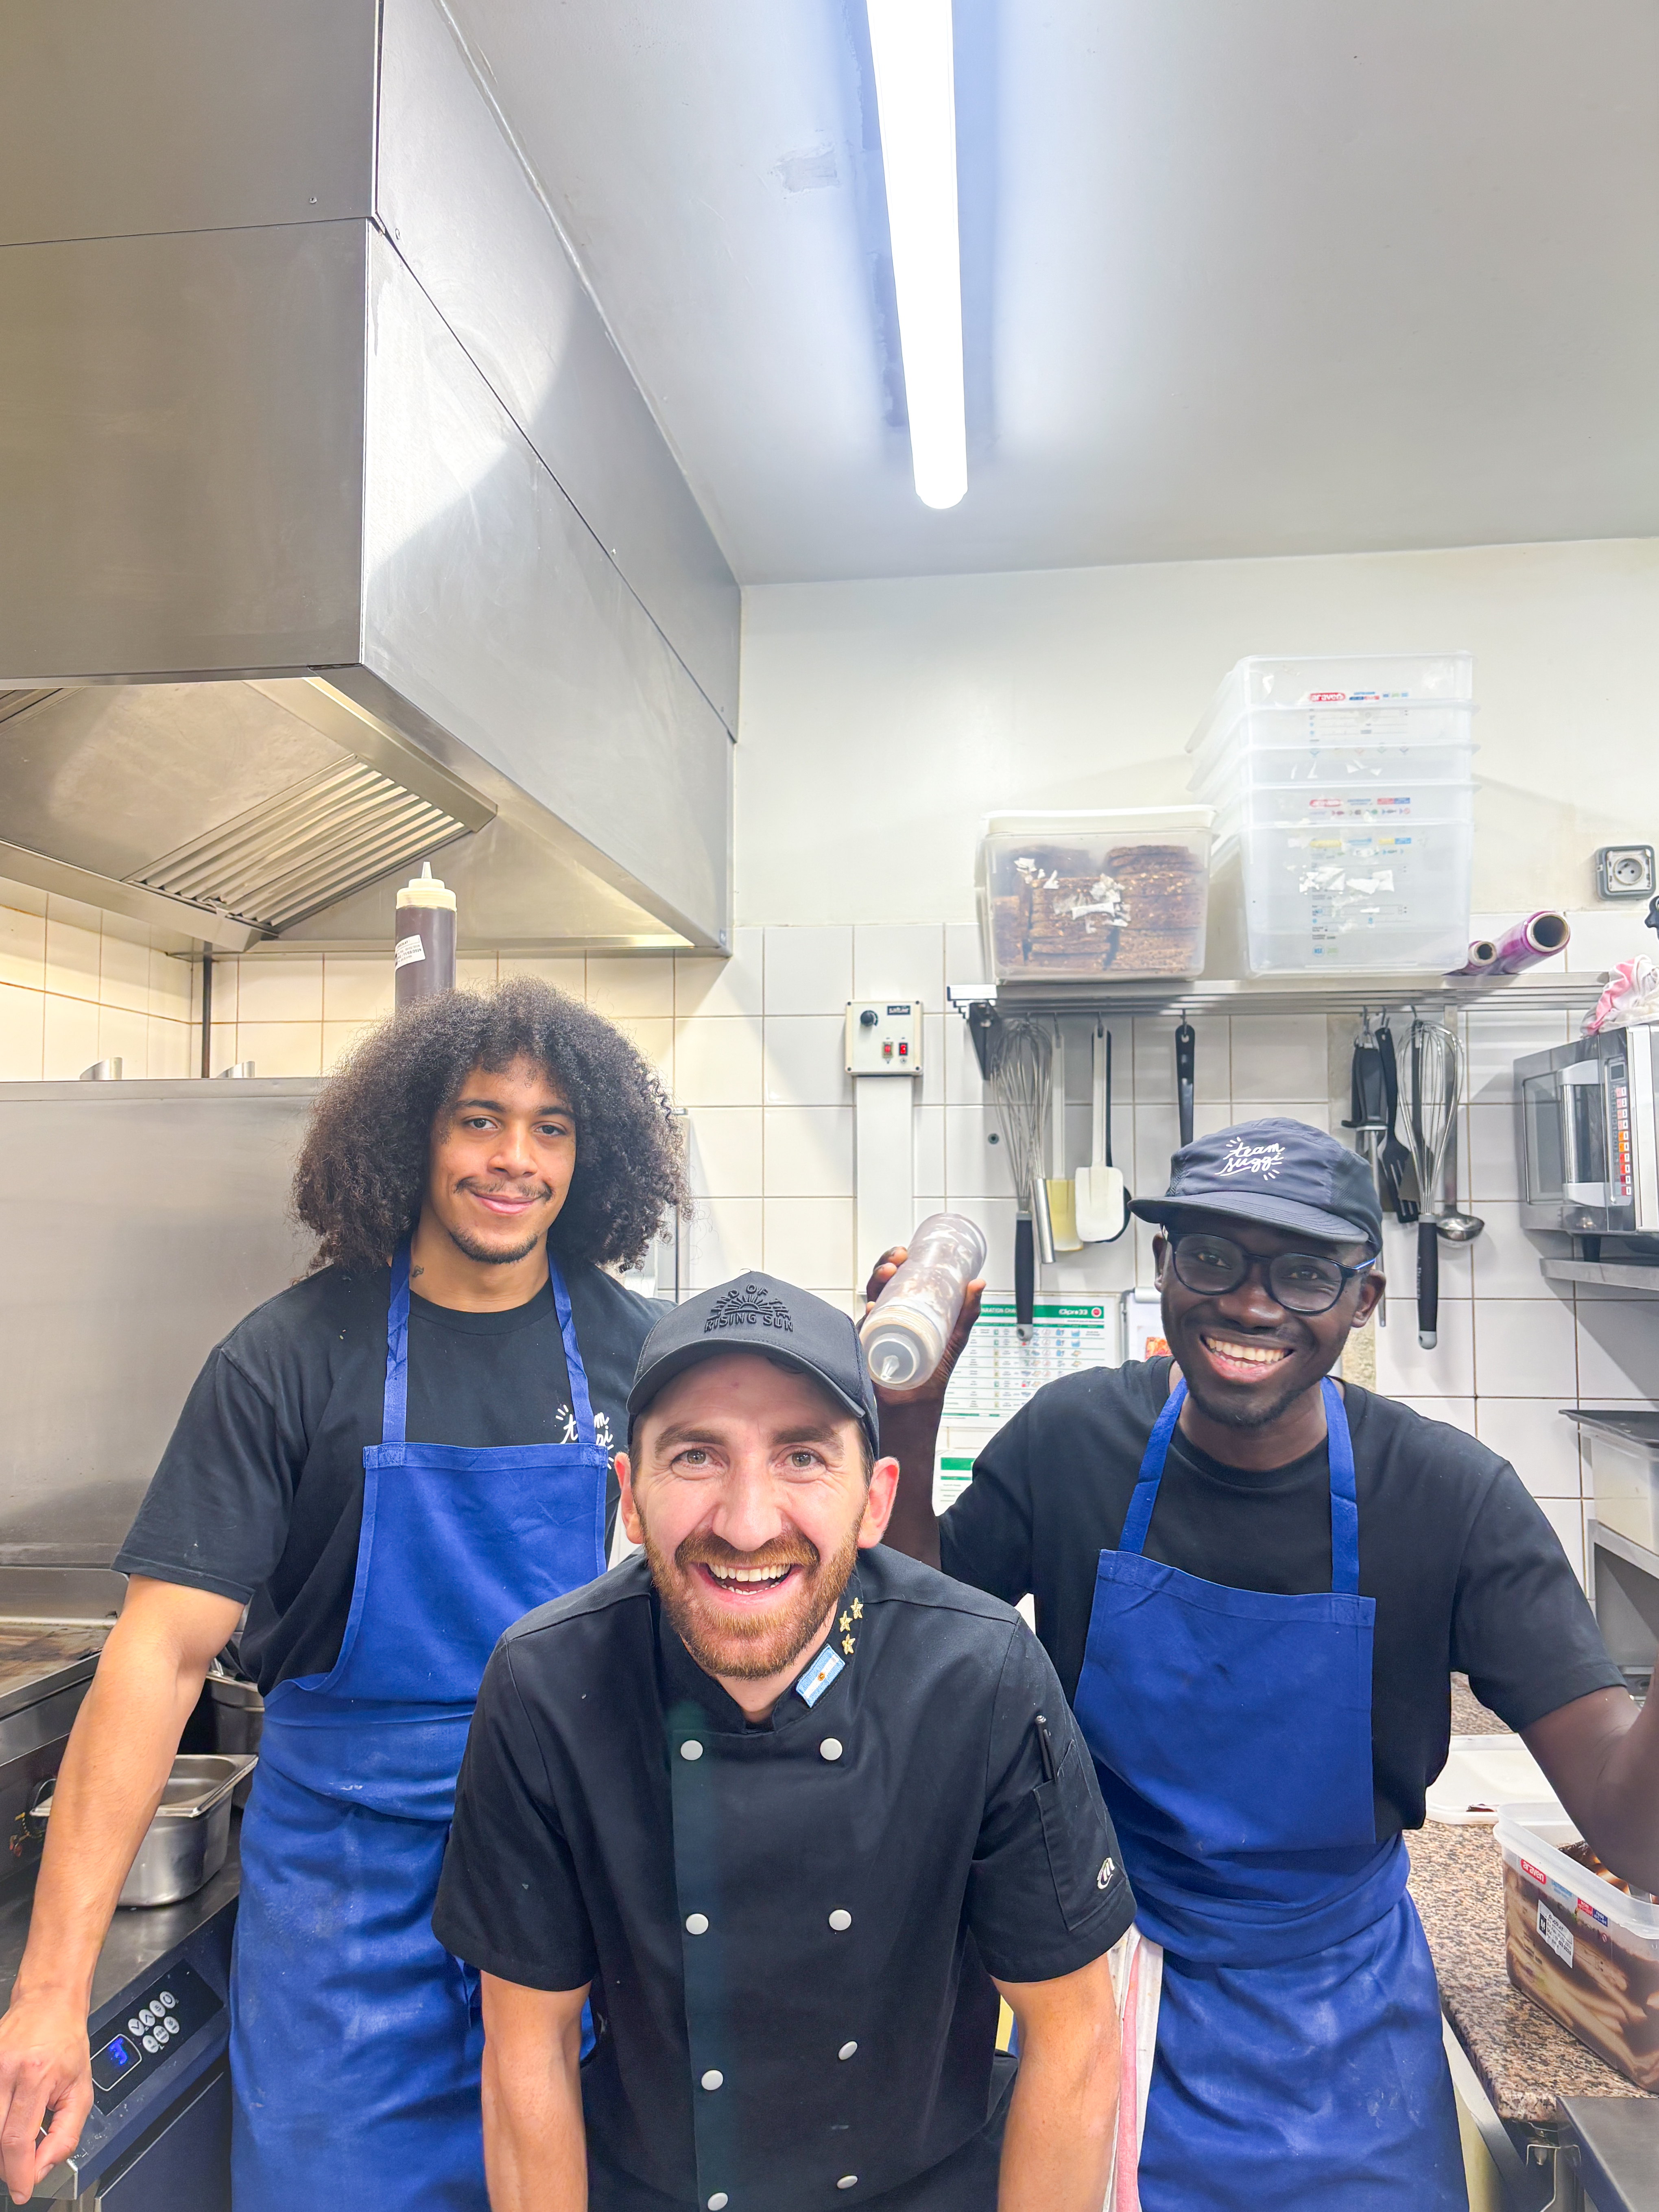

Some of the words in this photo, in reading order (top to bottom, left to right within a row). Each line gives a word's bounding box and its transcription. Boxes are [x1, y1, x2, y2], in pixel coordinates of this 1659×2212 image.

[1222, 1142, 1285, 1160] team
[745, 1283, 768, 1296] OF
[704, 1312, 757, 1333] RISING
[763, 1314, 794, 1332] SUN
[560, 1412, 610, 1444] tm
[1523, 1862, 1544, 1882] araven
